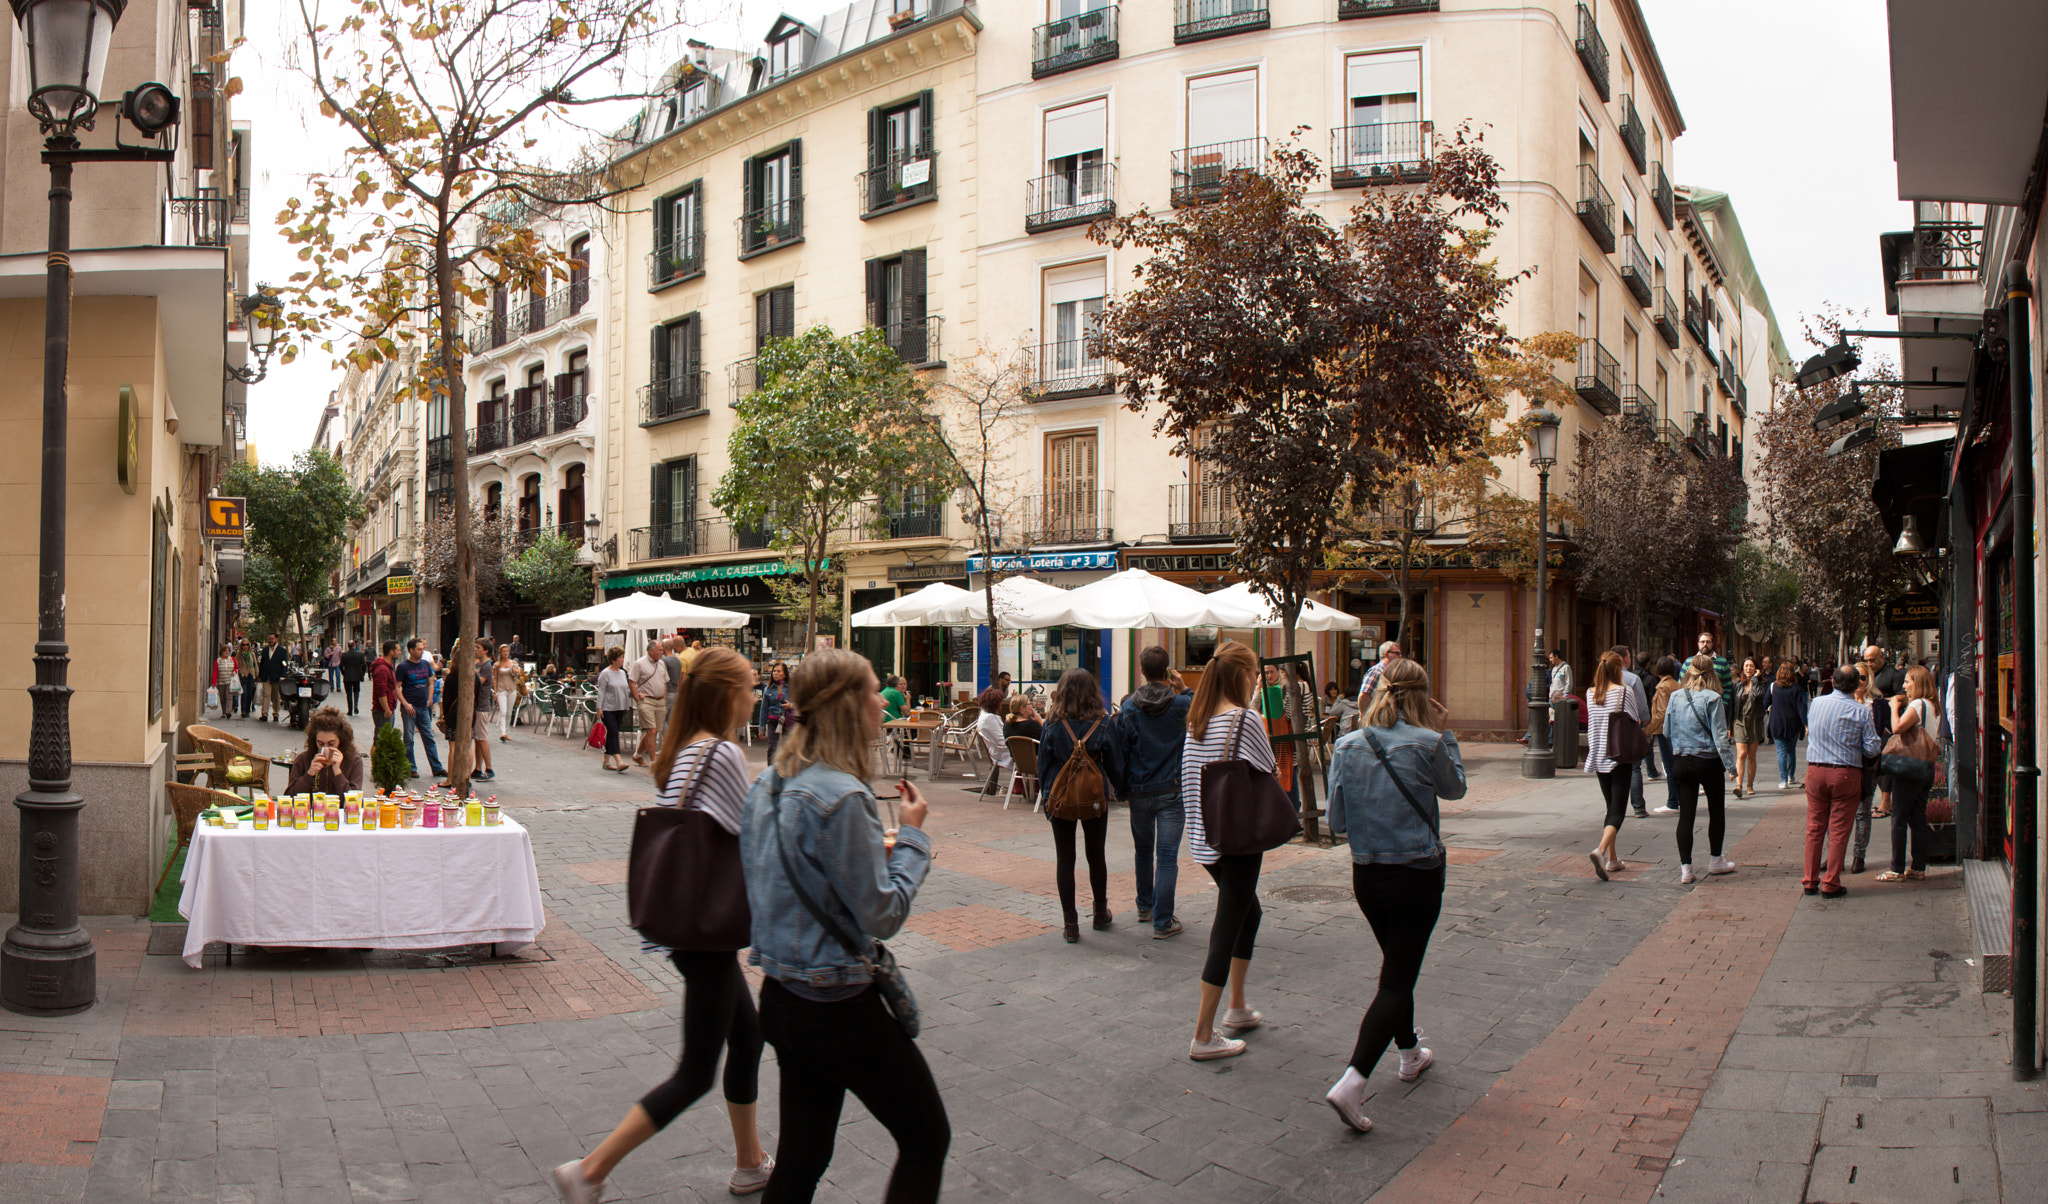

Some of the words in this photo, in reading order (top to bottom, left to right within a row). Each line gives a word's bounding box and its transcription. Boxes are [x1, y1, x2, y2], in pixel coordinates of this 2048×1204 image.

[206, 528, 243, 536] TABACOS
[1030, 556, 1063, 568] Lotería
[1084, 556, 1090, 566] 3
[726, 563, 779, 576] CABELLO
